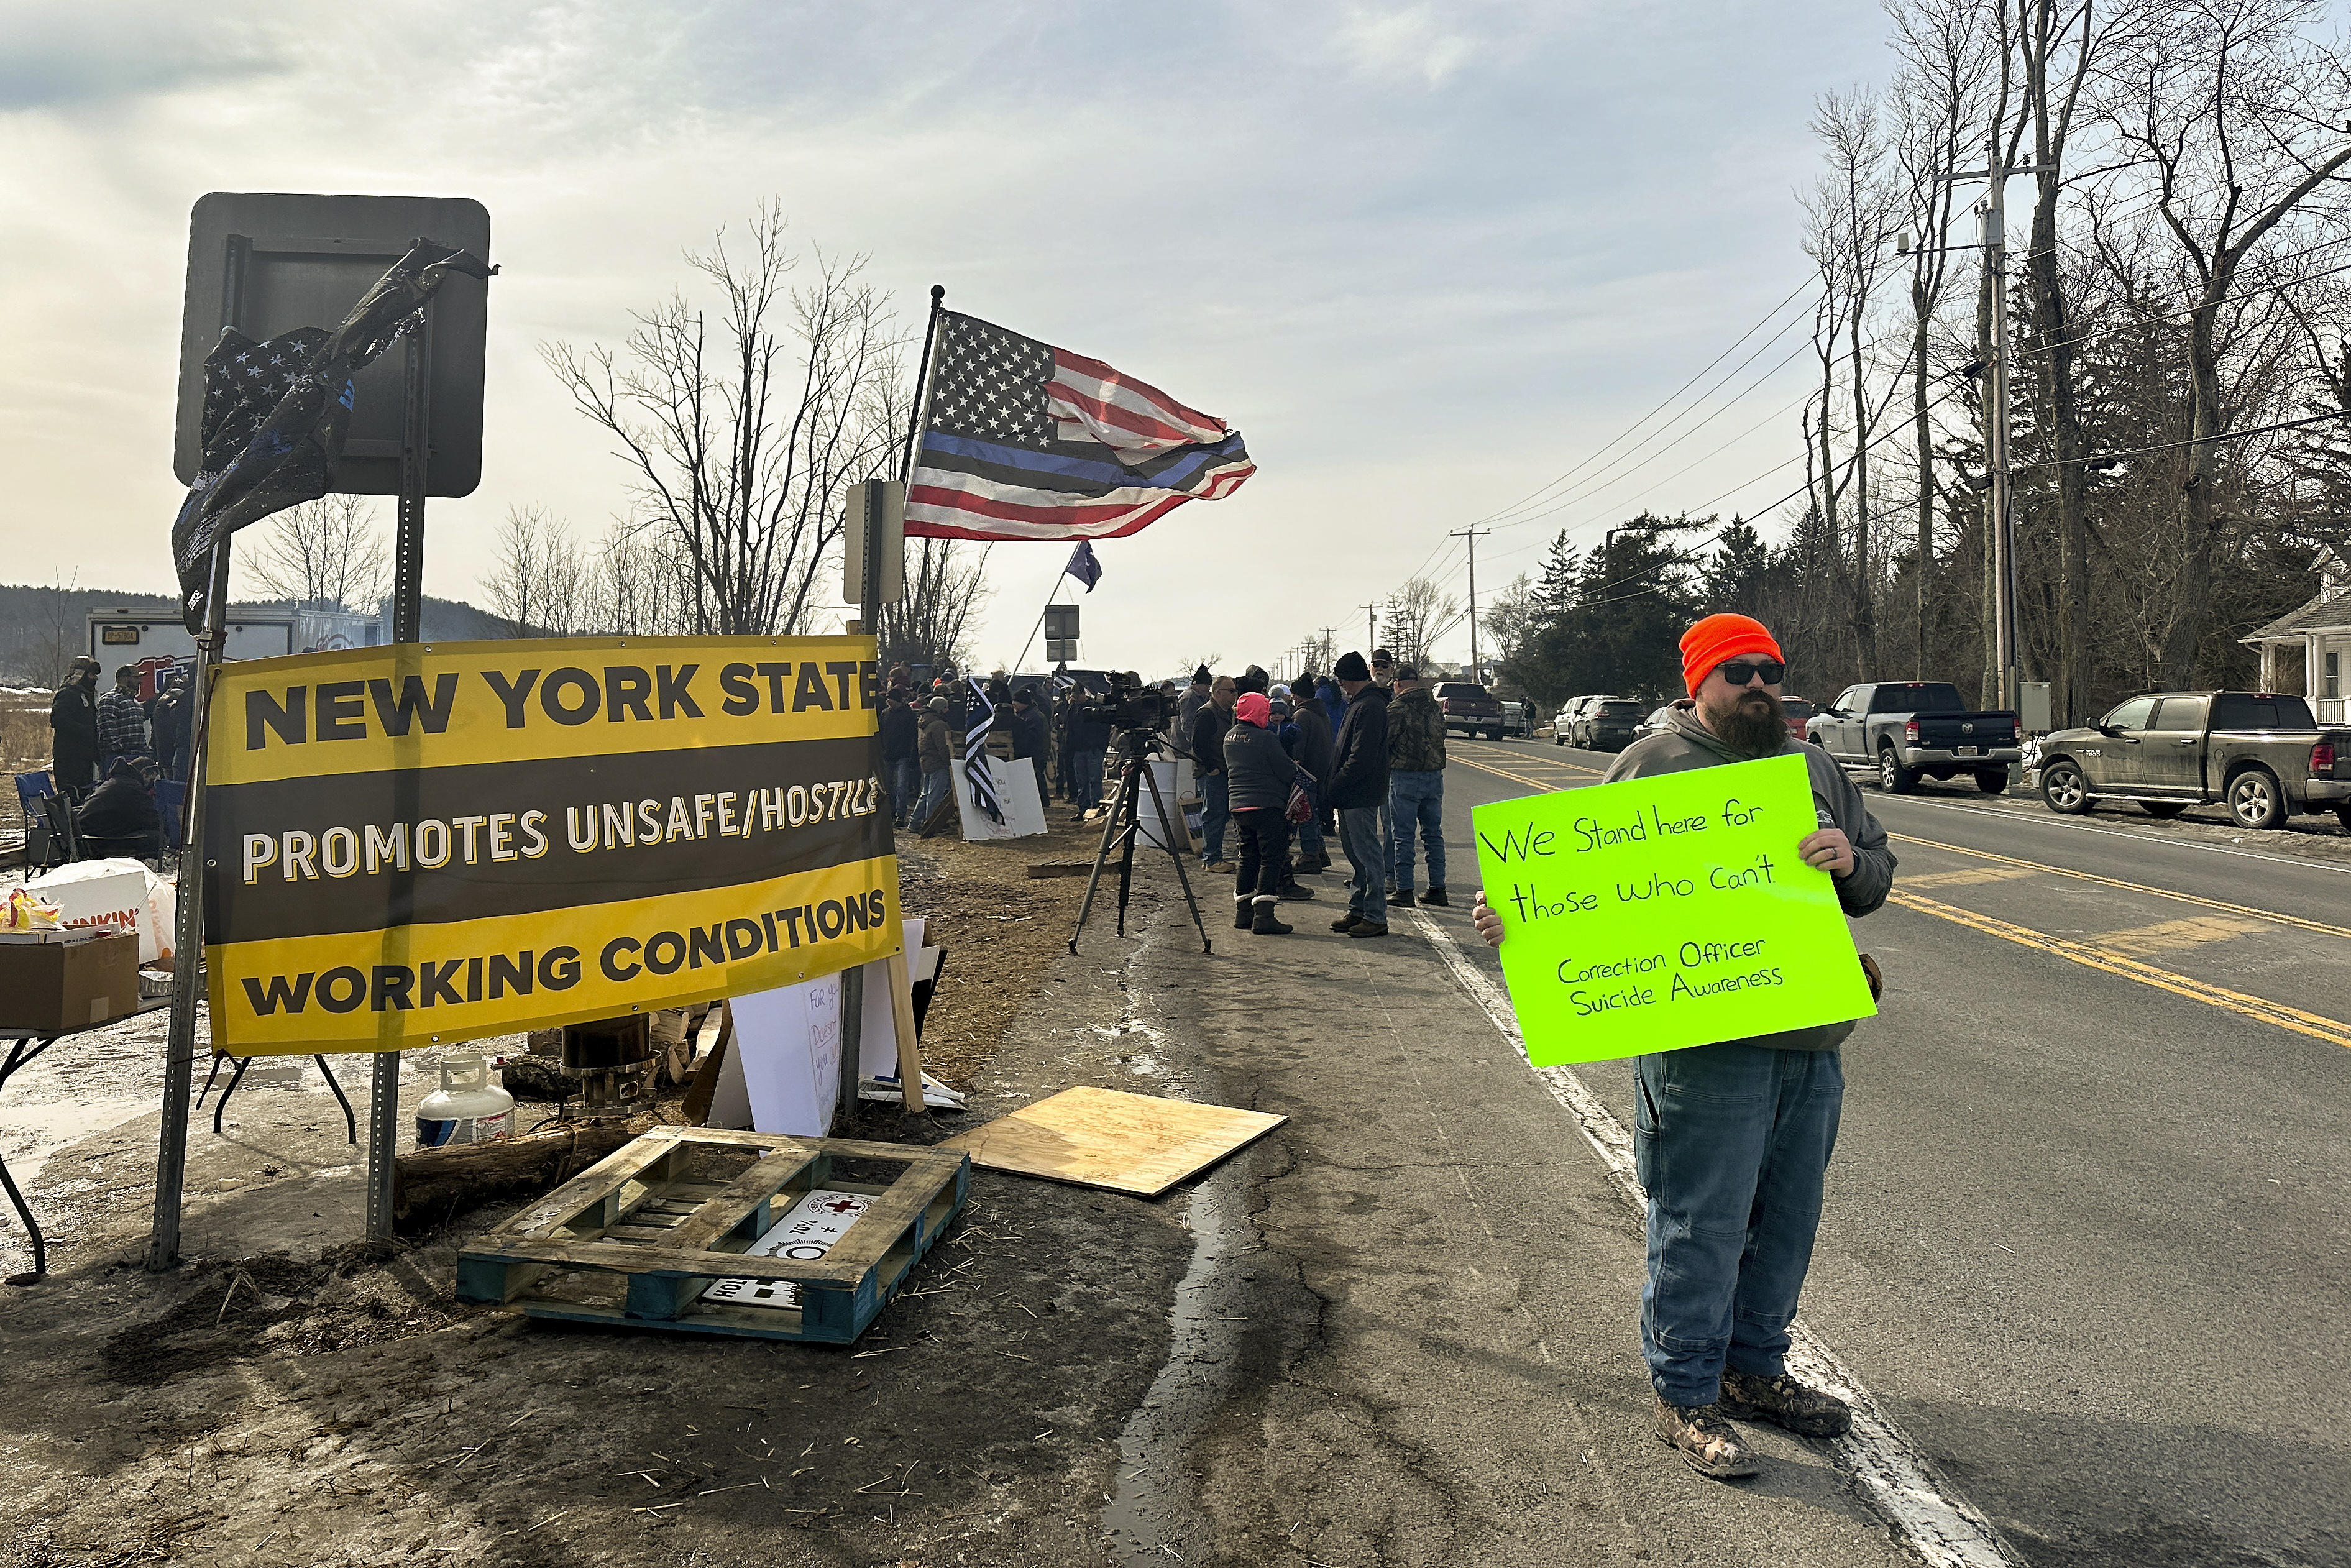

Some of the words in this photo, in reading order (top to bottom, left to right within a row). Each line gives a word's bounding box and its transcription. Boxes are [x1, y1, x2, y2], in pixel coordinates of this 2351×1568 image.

[245, 673, 459, 750] NEW
[479, 664, 705, 729] YORK
[719, 661, 876, 716] STATE
[242, 809, 549, 885] PROMOTES
[566, 777, 878, 853] UNSAFE/HOSTILE
[1479, 822, 1556, 864] We
[1574, 810, 1647, 853] Stand
[1653, 805, 1708, 835] here
[1721, 799, 1764, 828] for
[1509, 883, 1598, 923] those
[241, 945, 581, 1016] WORKING
[600, 889, 886, 981] CONDITIONS
[1558, 954, 1666, 984] Correction
[1680, 939, 1766, 968] Officer
[1570, 985, 1656, 1016] Suicide
[1671, 968, 1783, 1001] Awareness
